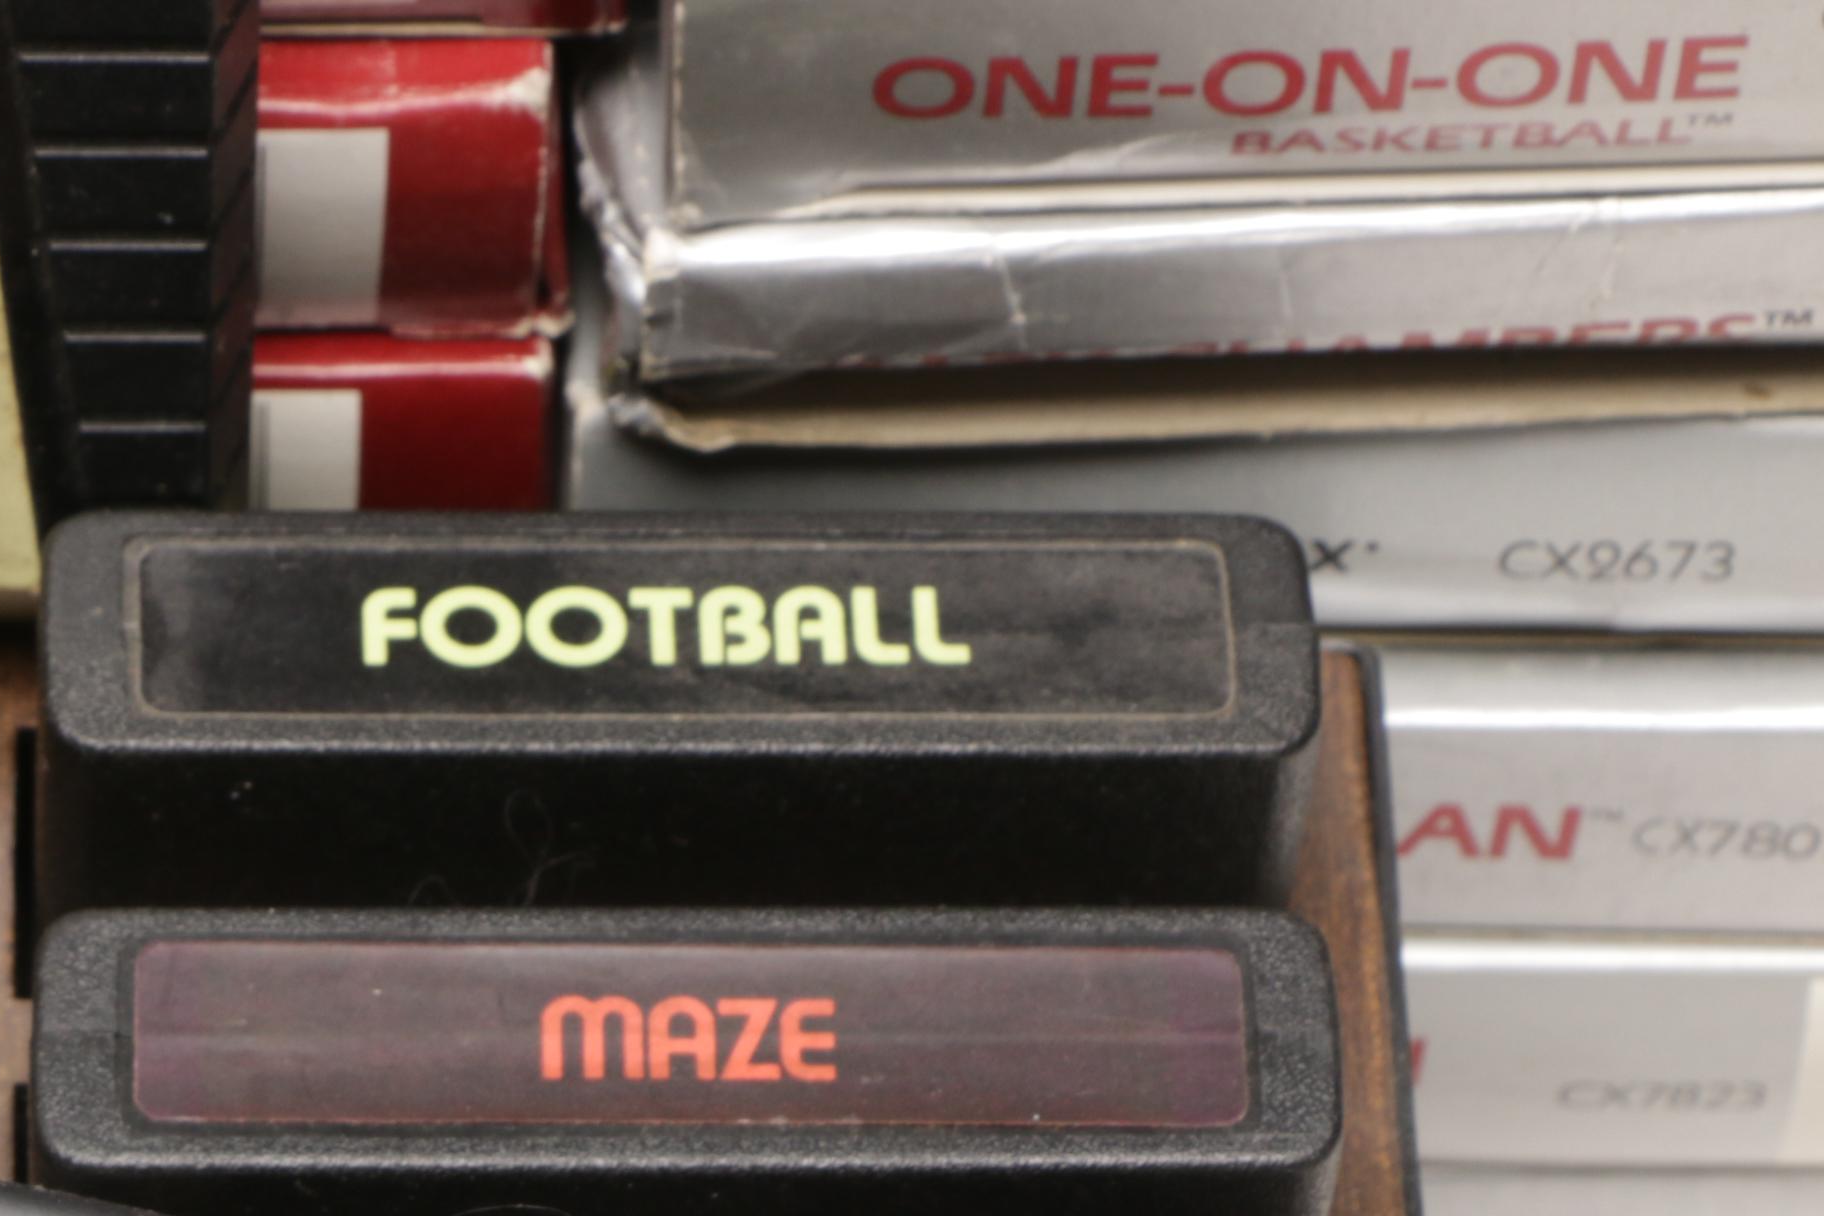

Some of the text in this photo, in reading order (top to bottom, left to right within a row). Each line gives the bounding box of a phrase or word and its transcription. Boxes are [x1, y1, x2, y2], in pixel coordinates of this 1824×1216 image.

[872, 36, 1750, 120] ONE-ON-ONE
[1496, 537, 1738, 583] CX2673
[361, 585, 972, 668] FOOTBALL
[539, 994, 837, 1084] MAZE
